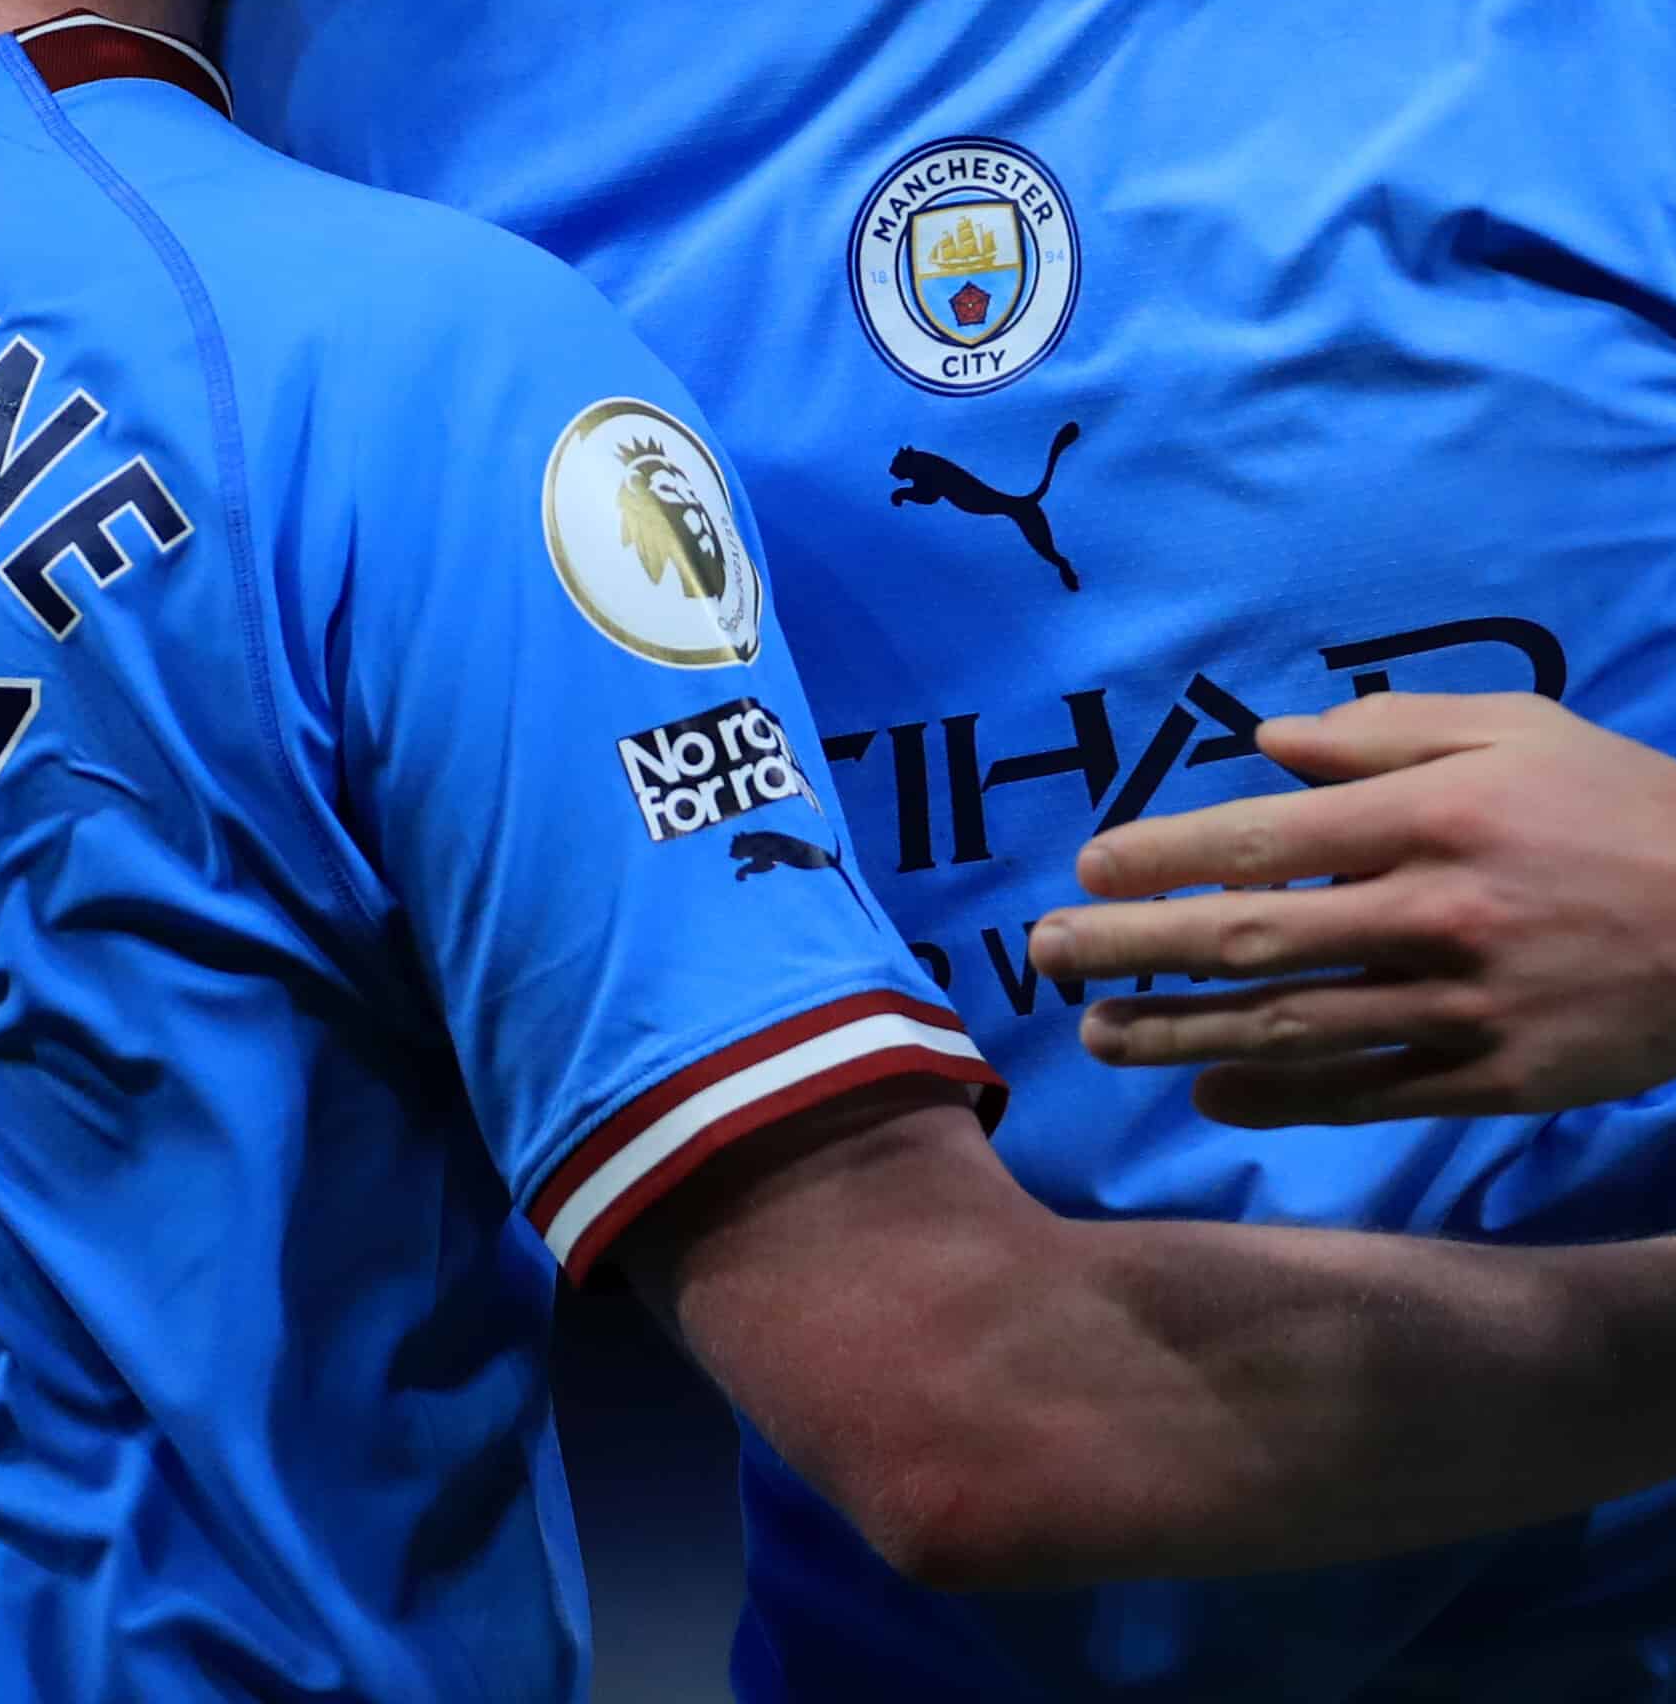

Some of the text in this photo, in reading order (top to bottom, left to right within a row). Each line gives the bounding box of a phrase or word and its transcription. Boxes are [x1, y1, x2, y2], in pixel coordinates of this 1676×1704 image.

[873, 157, 1053, 243] MANCHESTER
[941, 349, 1007, 378] CITY
[618, 727, 716, 795] No
[637, 774, 725, 842] for
